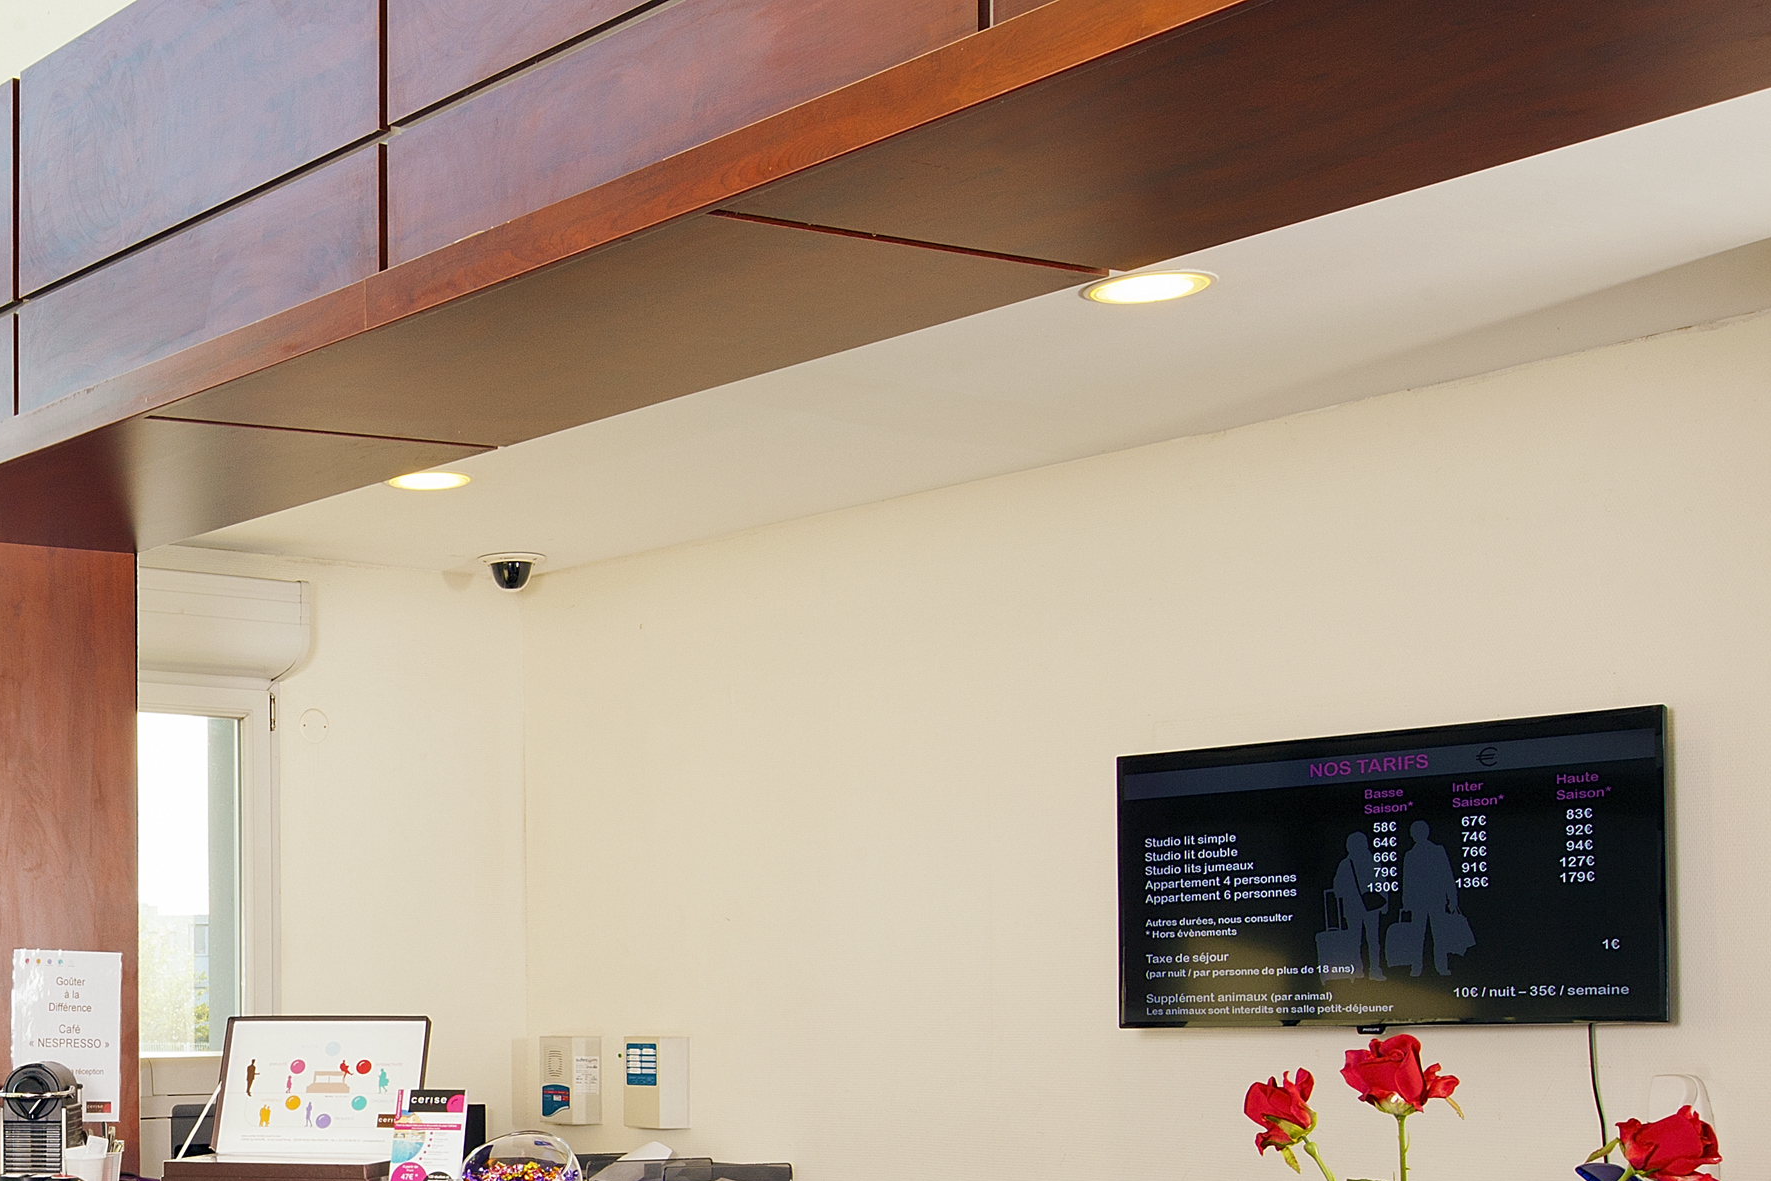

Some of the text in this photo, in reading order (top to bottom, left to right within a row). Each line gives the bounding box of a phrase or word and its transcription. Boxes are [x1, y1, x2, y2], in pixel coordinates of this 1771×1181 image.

[1309, 761, 1351, 778] NOS
[1356, 754, 1429, 775] TARIFS
[1556, 772, 1599, 785] Haute
[1452, 781, 1484, 793] Inter
[1364, 788, 1404, 800] Basse
[1566, 808, 1593, 820] 83€
[1373, 821, 1397, 833] 58€
[1461, 815, 1487, 828] 67€
[1566, 823, 1593, 836] 92€
[1145, 833, 1237, 848] Studio lit simple
[1373, 836, 1397, 848] 64€
[1461, 830, 1487, 842] 74€
[1461, 845, 1487, 858] 76€
[1566, 839, 1593, 852] 94€
[1145, 847, 1238, 862] Studio lit double
[1373, 851, 1397, 863] 66€
[1461, 861, 1487, 873] 91€
[1559, 855, 1595, 868] 127€
[1145, 861, 1254, 876] Studio lits jumeaux
[1373, 866, 1398, 878] 79€
[1145, 874, 1297, 892] Appartement 4 personnes
[1455, 876, 1489, 889] 136€
[1559, 871, 1595, 884] 179€
[1367, 881, 1399, 893] 130€
[1145, 888, 1297, 905] Appartement 6 personnes
[1145, 913, 1293, 928] Autres durées, nous consulter
[1152, 929, 1175, 939] Hors
[1177, 927, 1237, 938] évènements
[1602, 938, 1620, 950] 1€
[1146, 952, 1229, 965] Taxe de séjour
[1145, 969, 1166, 980] (par
[1167, 968, 1186, 978] nuit
[1193, 970, 1210, 979] par
[1212, 968, 1260, 978] personne
[1261, 967, 1275, 976] de
[1276, 966, 1298, 977] plus
[1300, 965, 1315, 975] de
[1316, 965, 1329, 974] 18
[1331, 964, 1355, 975] ans)
[56, 976, 85, 986] Goûter
[64, 990, 80, 999] à la
[1453, 986, 1479, 998] 10€
[1489, 986, 1516, 997] nuit
[1529, 985, 1556, 996] 35€
[1567, 984, 1630, 996] semaine
[1146, 991, 1333, 1005] Supplément animaux (par animal)
[48, 1003, 92, 1013] Différence
[1146, 1003, 1393, 1016] Les animaux sont interdits en salle petit-déjeuner
[59, 1024, 80, 1034] Café
[37, 1038, 101, 1048] NESPRESSO
[75, 1068, 104, 1076] réception
[411, 1096, 447, 1104] cerise
[400, 1173, 414, 1181] 47€
